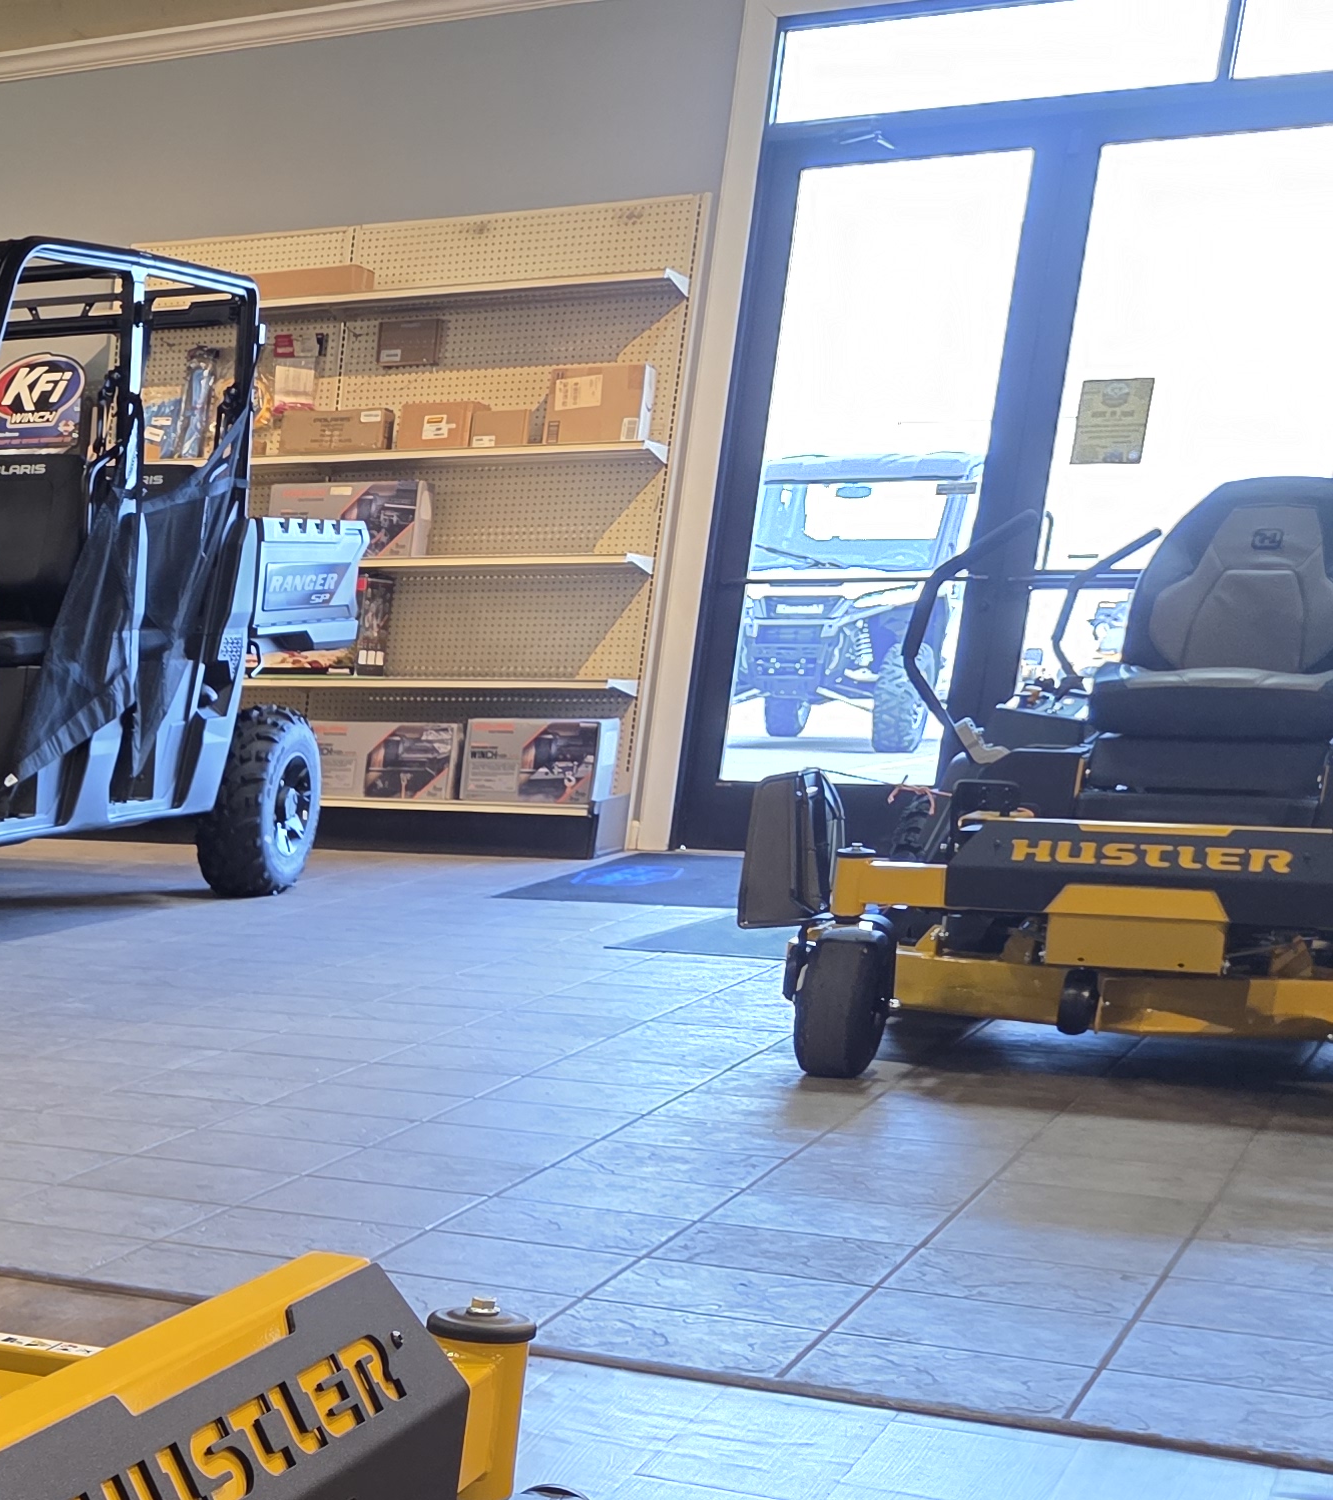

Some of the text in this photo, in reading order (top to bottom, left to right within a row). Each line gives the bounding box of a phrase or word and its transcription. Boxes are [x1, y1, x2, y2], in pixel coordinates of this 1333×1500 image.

[1, 366, 73, 411] KFi
[10, 410, 58, 425] WINCH
[268, 573, 338, 593] RANGER
[309, 593, 331, 604] SP
[1010, 838, 1293, 873] HUSTLER
